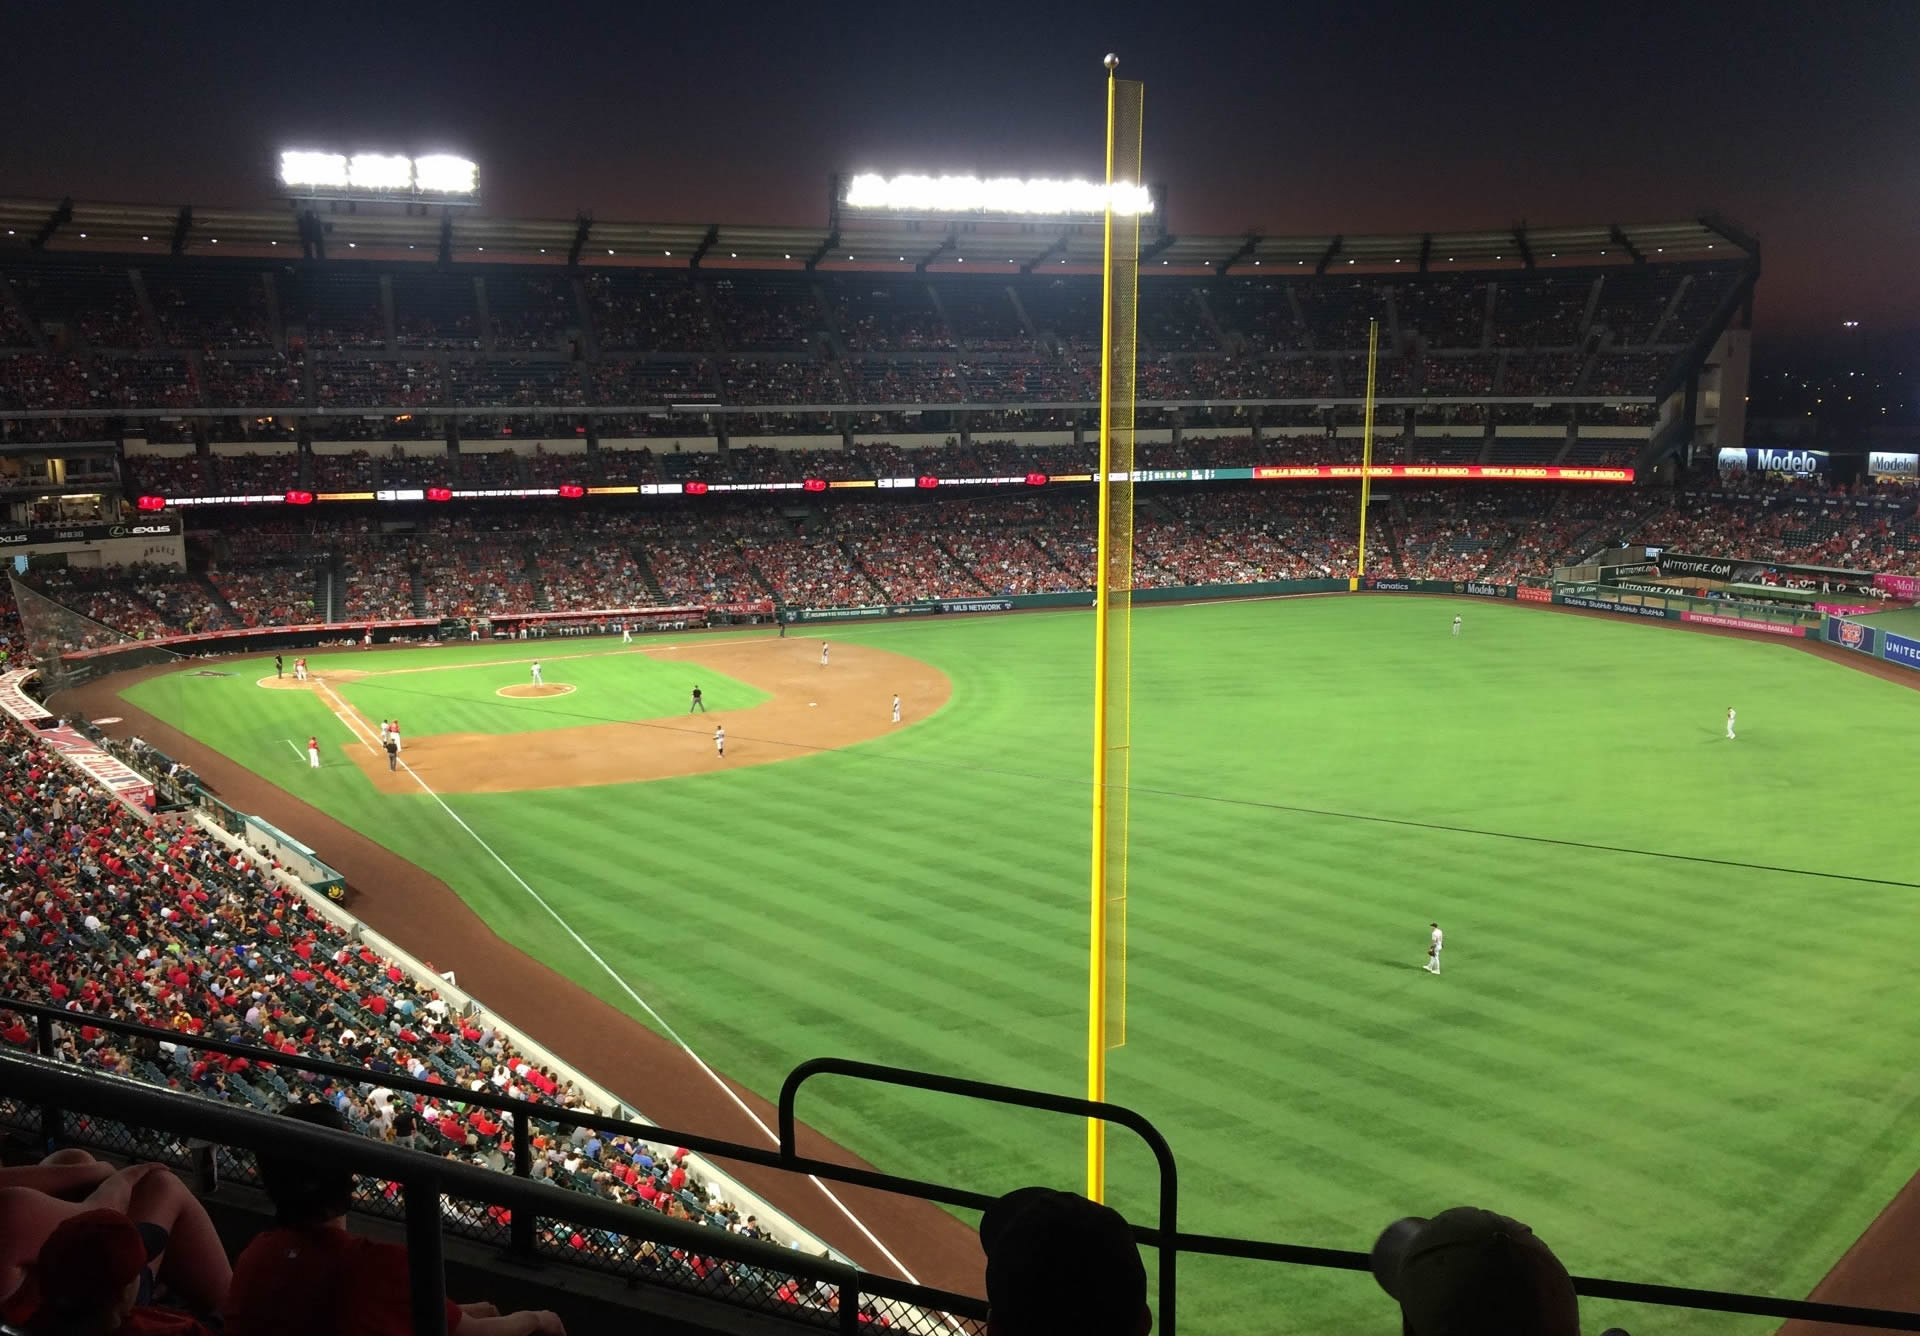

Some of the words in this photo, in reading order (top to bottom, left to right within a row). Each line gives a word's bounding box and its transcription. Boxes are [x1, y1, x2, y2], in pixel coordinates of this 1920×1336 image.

[1757, 448, 1817, 472] Modelo
[1875, 456, 1912, 472] Modelo
[1260, 468, 1289, 476] WELLS
[1290, 468, 1320, 476] FARGO
[1481, 468, 1514, 476] WELLS
[1514, 468, 1547, 476] FARGO
[1560, 469, 1592, 478] WELLS
[1592, 470, 1625, 479] FARGO
[125, 525, 170, 533] LEXUS
[1663, 559, 1731, 576] NITTOTIRE.COM
[1376, 582, 1408, 590] Fanatics
[1467, 583, 1495, 595] Modelo
[953, 604, 967, 612] MLB
[968, 603, 1001, 611] NETWORK
[1564, 597, 1587, 607] StubHub
[1588, 600, 1612, 610] StubHub
[1614, 603, 1638, 613] StubHub
[1640, 607, 1665, 617] StubHub
[1690, 614, 1702, 622] BEST
[1702, 616, 1726, 625] NETWORK
[1727, 618, 1737, 626] FOR
[1738, 620, 1768, 630] STREAMING
[1768, 624, 1793, 634] BASEBALL
